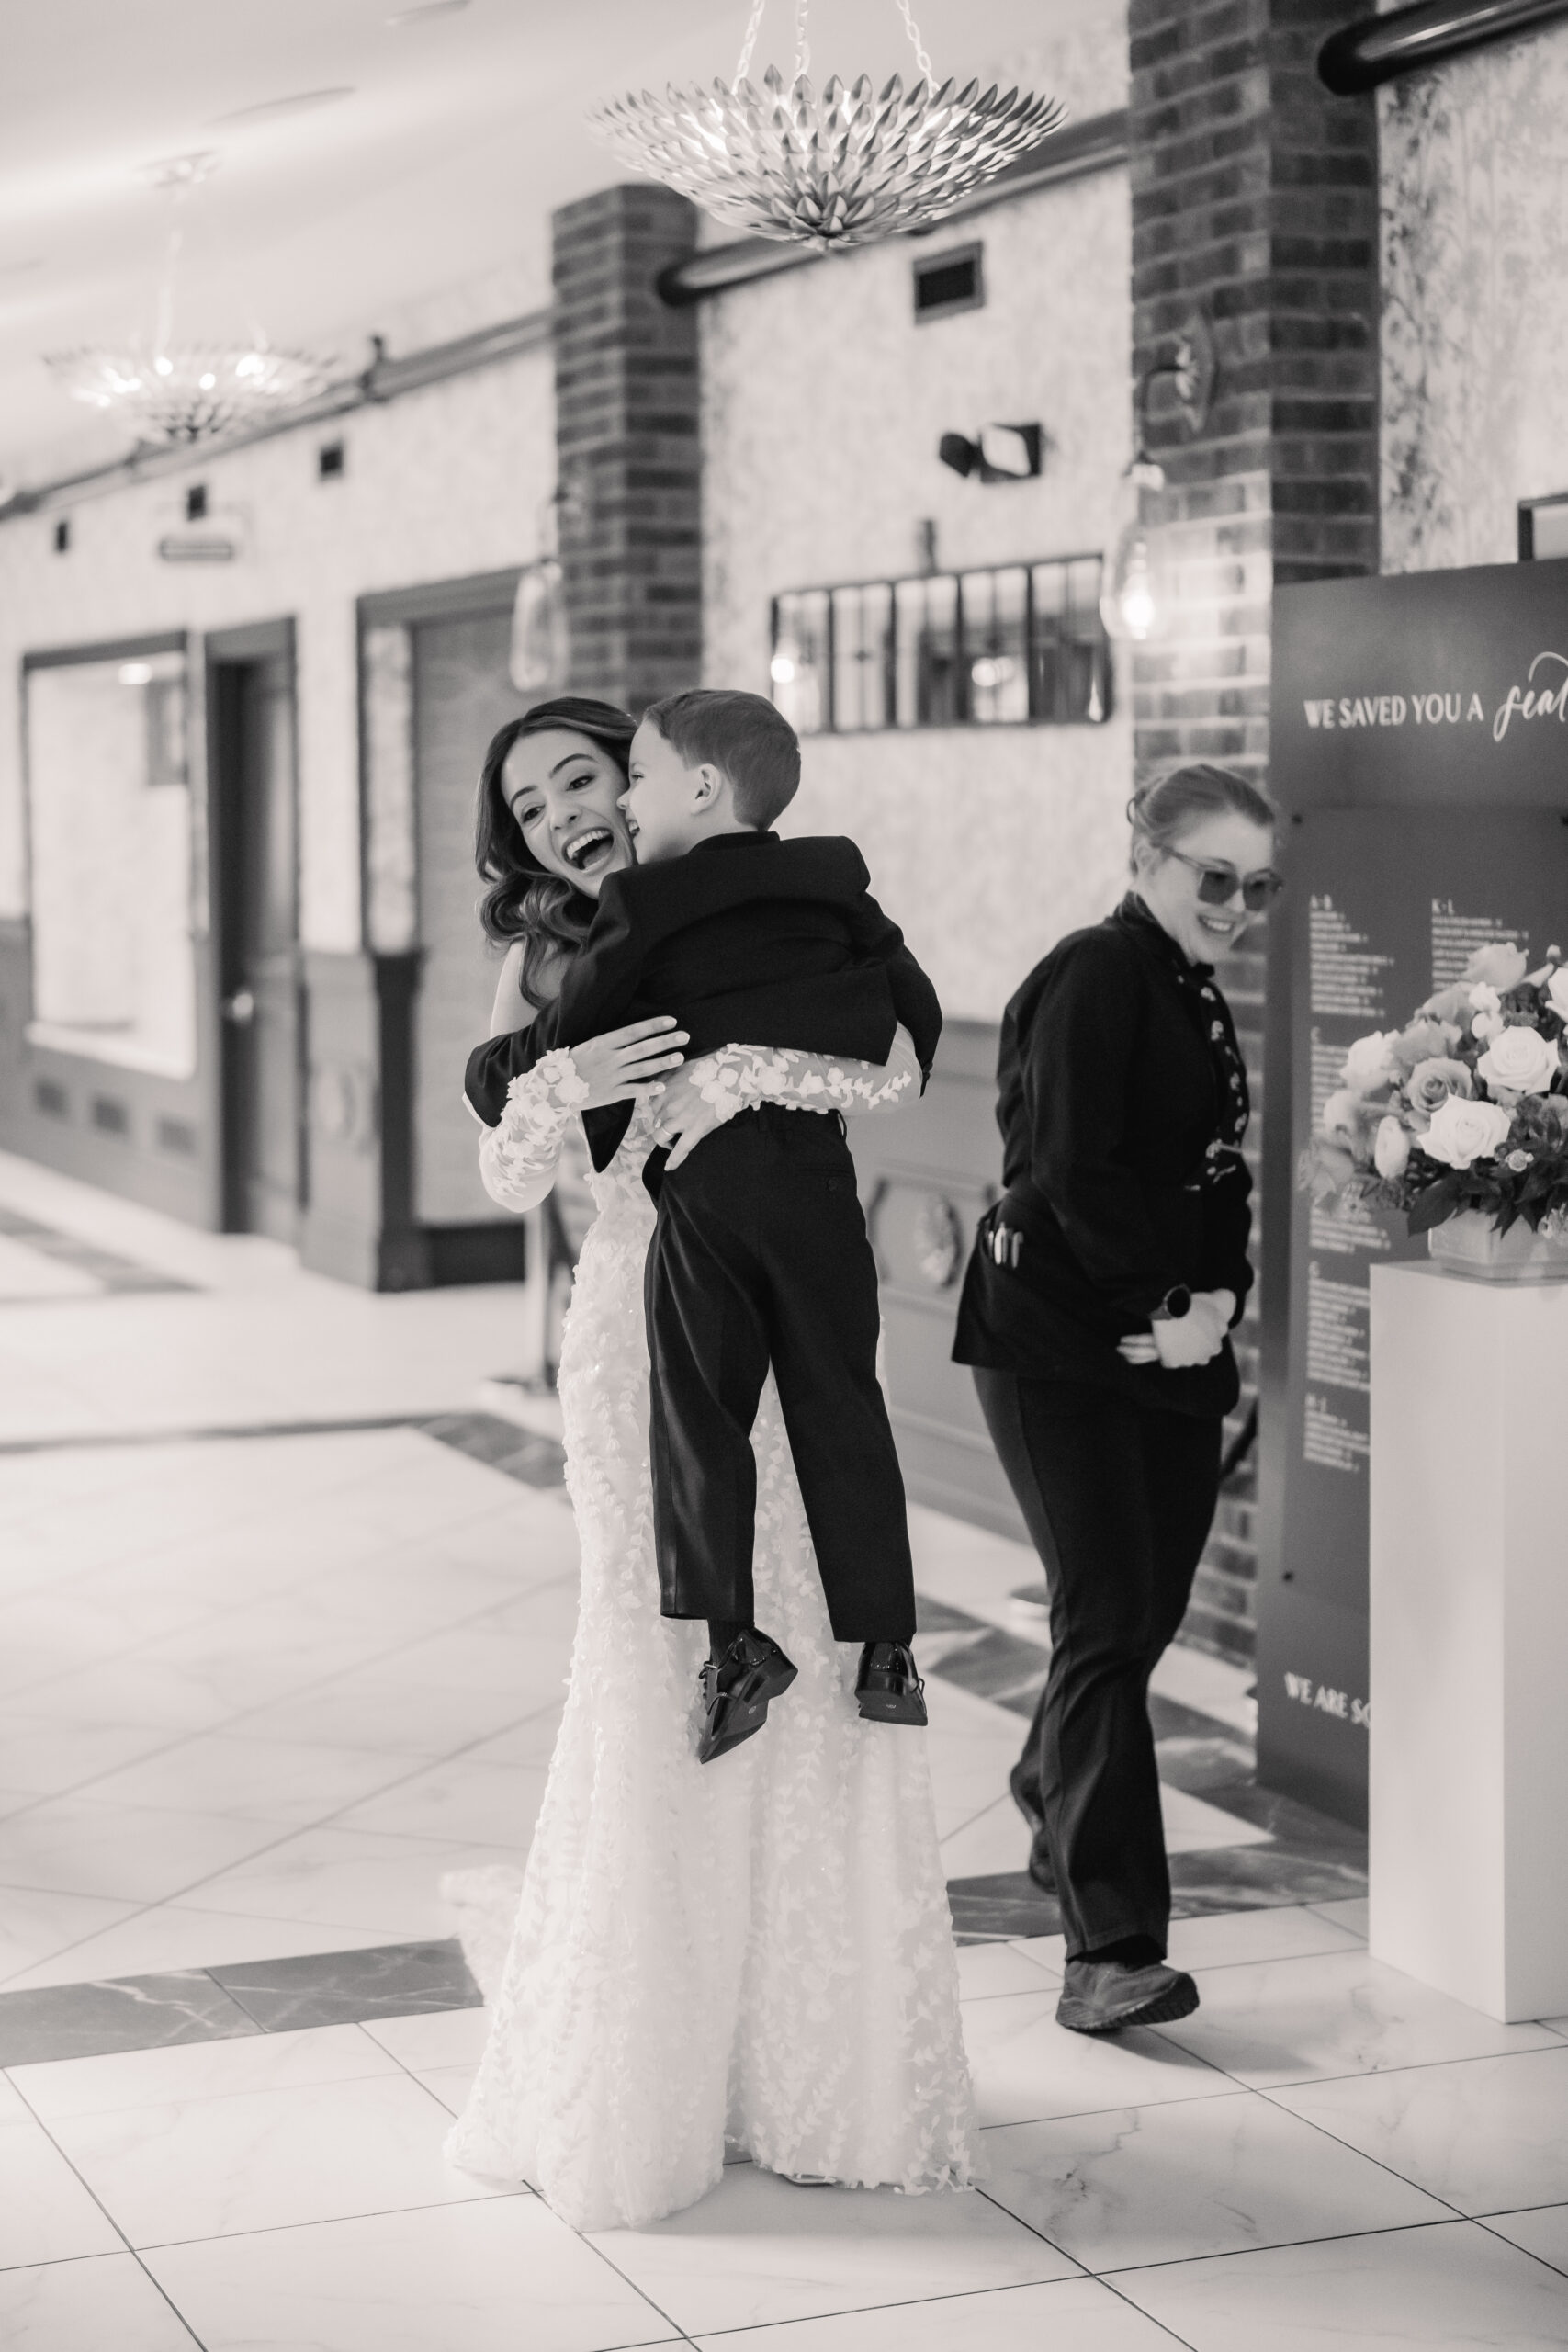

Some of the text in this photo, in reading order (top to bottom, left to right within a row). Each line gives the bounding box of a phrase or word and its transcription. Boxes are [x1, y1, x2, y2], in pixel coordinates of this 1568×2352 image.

[1303, 699, 1335, 729] WE
[1339, 695, 1407, 729] SAVED
[1411, 693, 1461, 725] YOU
[1467, 692, 1484, 722] A
[1284, 1671, 1313, 1705] WE
[1313, 1684, 1348, 1719] ARE
